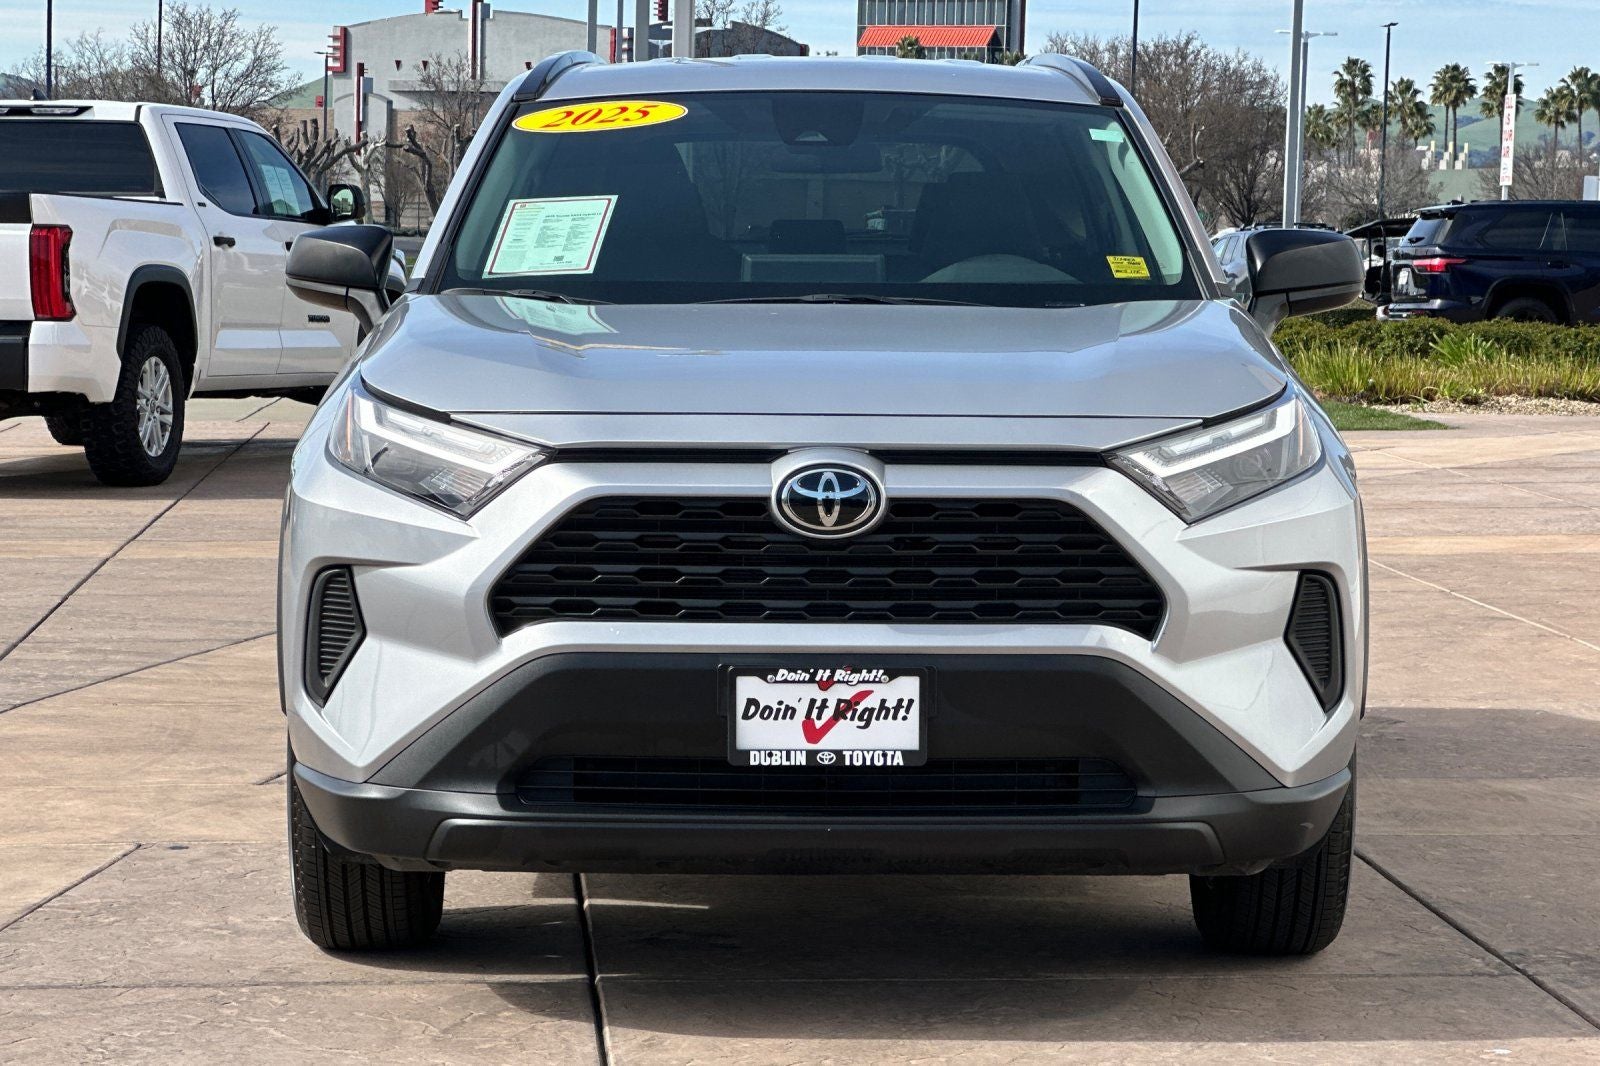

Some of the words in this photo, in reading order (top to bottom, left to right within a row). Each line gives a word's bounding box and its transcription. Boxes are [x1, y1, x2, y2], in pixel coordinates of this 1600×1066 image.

[540, 104, 660, 129] 2025
[775, 668, 814, 682] Doin'
[815, 669, 831, 682] It
[833, 669, 885, 686] Right!
[741, 697, 802, 721] Doin'
[804, 697, 830, 721] It
[832, 697, 914, 729] Right!
[749, 750, 807, 766] DUBLIN
[842, 750, 904, 766] TOYOTA
